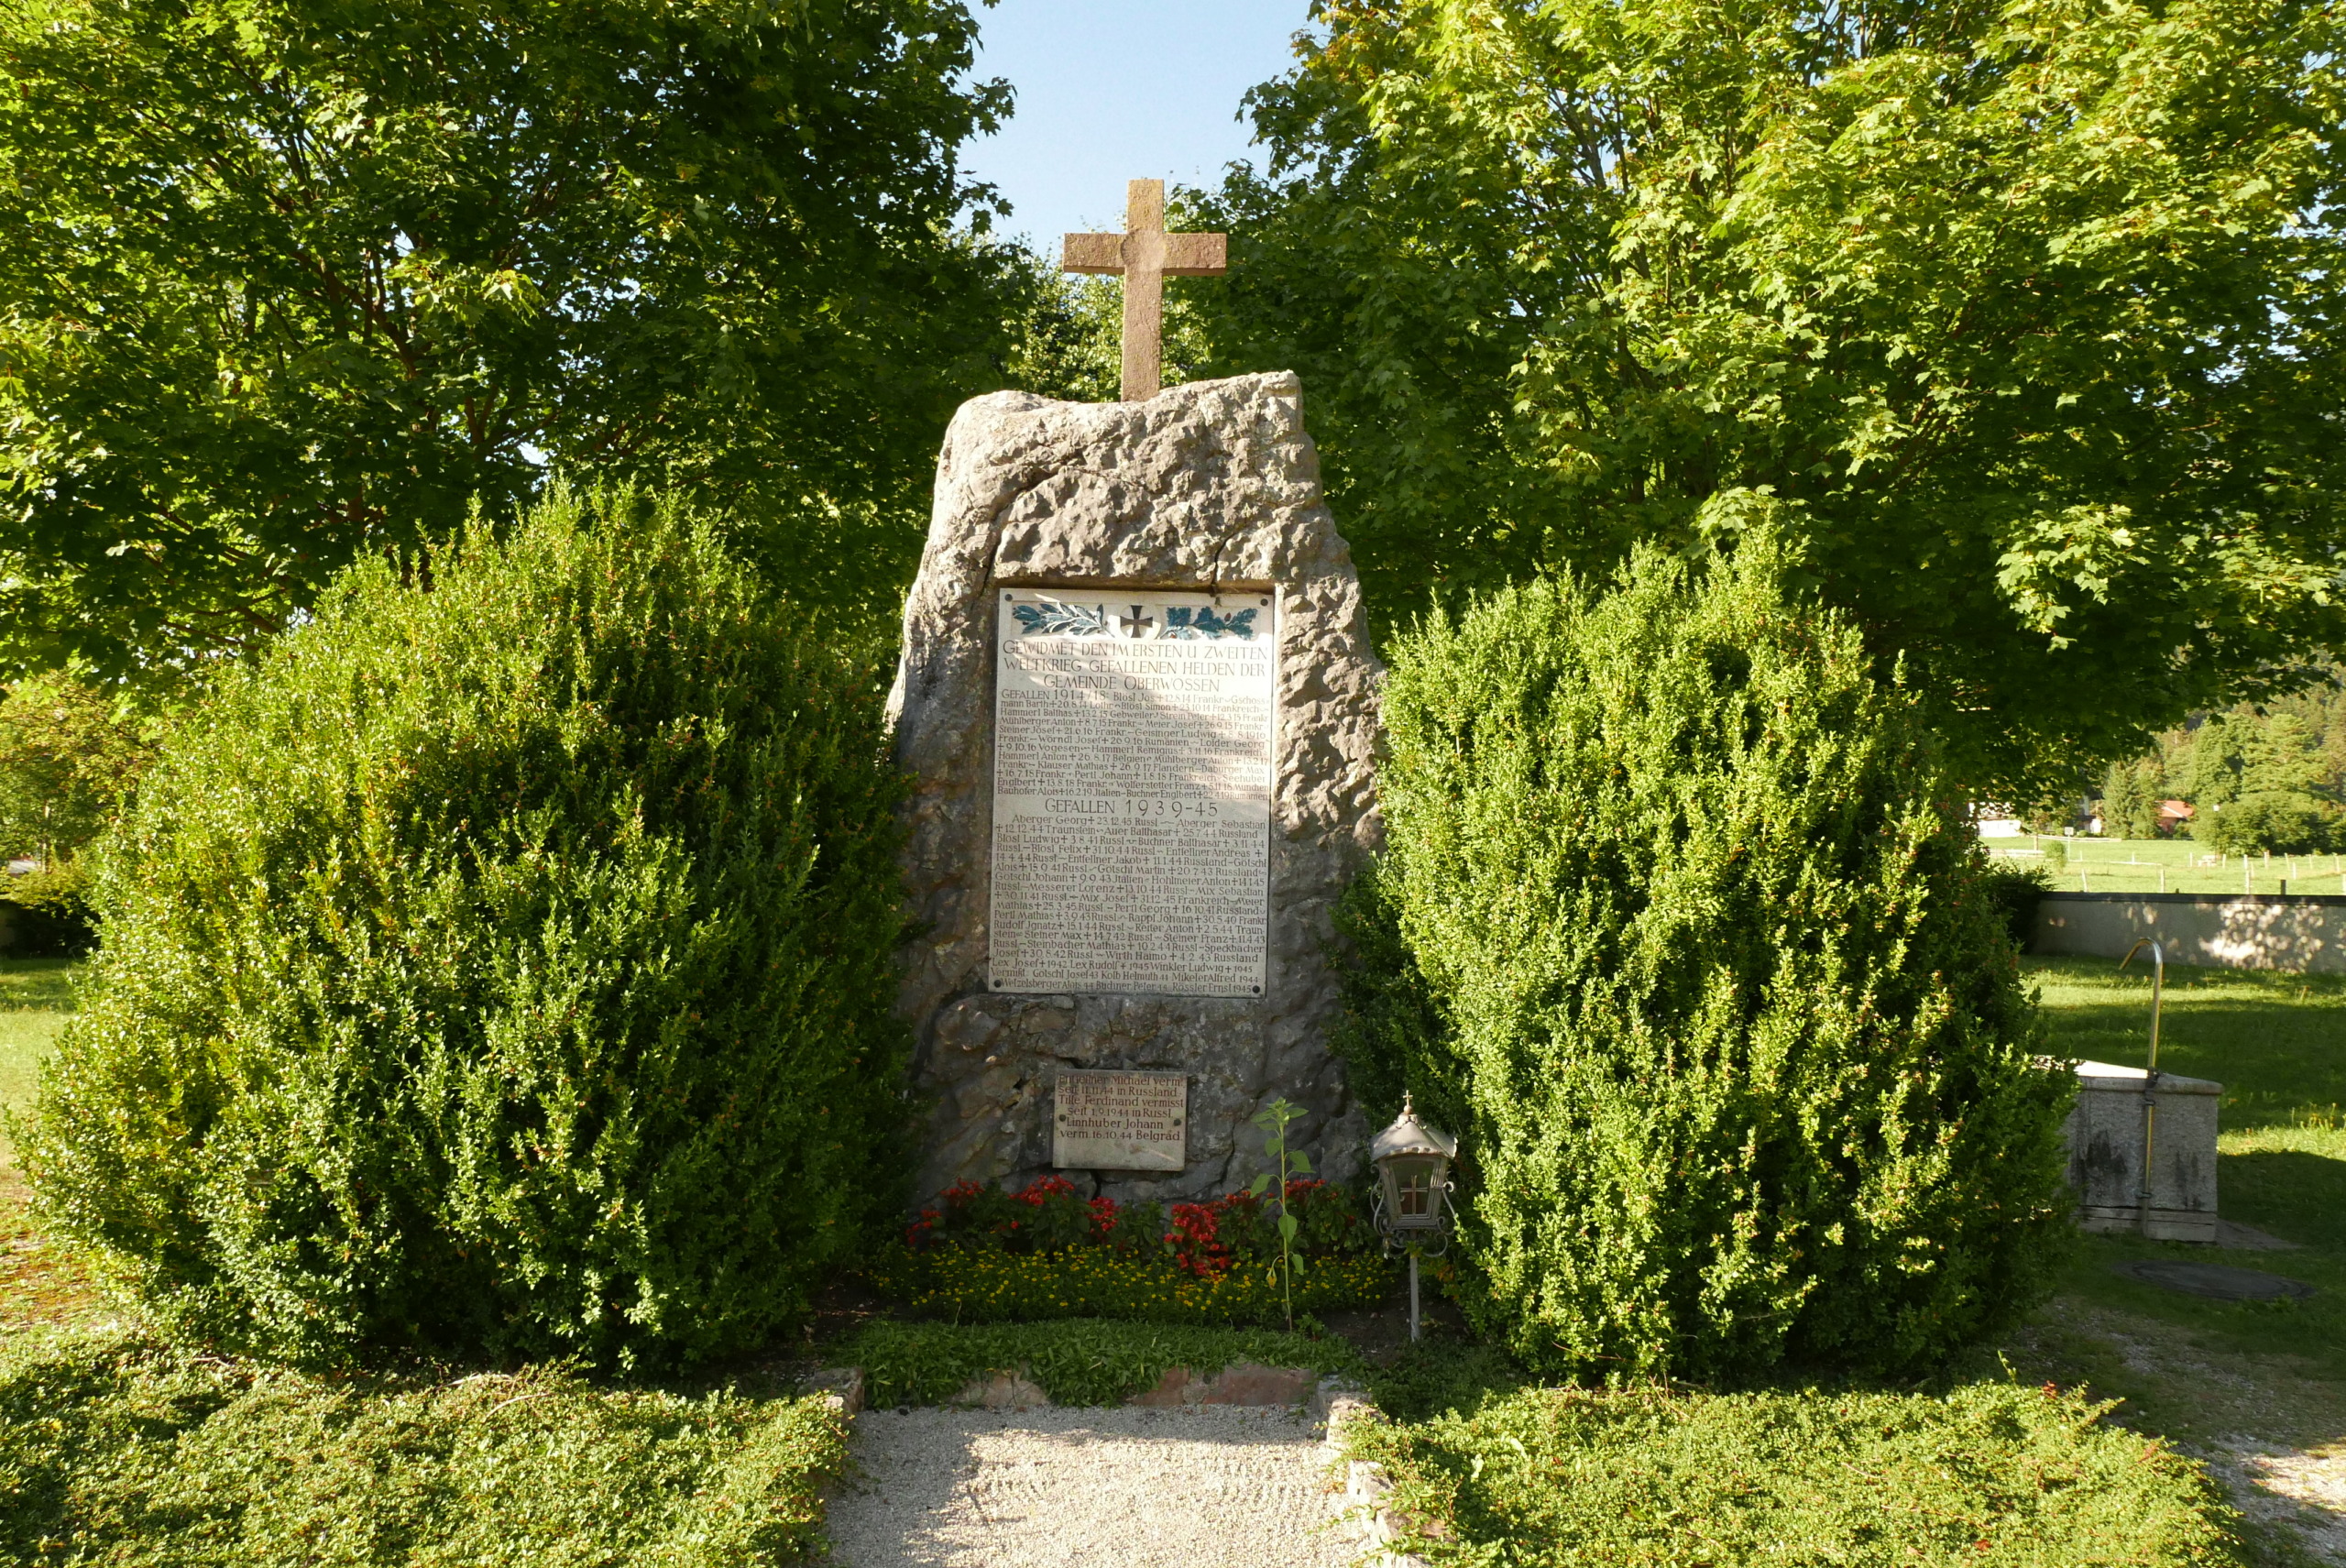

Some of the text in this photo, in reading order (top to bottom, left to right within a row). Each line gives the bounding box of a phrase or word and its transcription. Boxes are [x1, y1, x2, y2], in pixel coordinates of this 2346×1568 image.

[1003, 640, 1078, 655] GEWIDMET
[1082, 642, 1108, 655] DEN
[1113, 643, 1128, 656] IM
[1133, 644, 1181, 658] ERSTEN
[1204, 646, 1267, 660] ZWEITEN
[1004, 658, 1265, 676] WELTKRIEG GEFALLENEN HELDEN DER
[1044, 674, 1219, 692] GEMEINDE OBERWOSSEN
[1002, 689, 1049, 699] GEFALLEN
[1045, 799, 1115, 814] GEFALLEN
[1056, 816, 1087, 827] Georg
[1112, 1076, 1149, 1085] Michael
[1085, 1095, 1139, 1106] Ferdinand
[1142, 1099, 1183, 1107] vermisst
[1067, 1117, 1163, 1129] Linnhuber Johann
